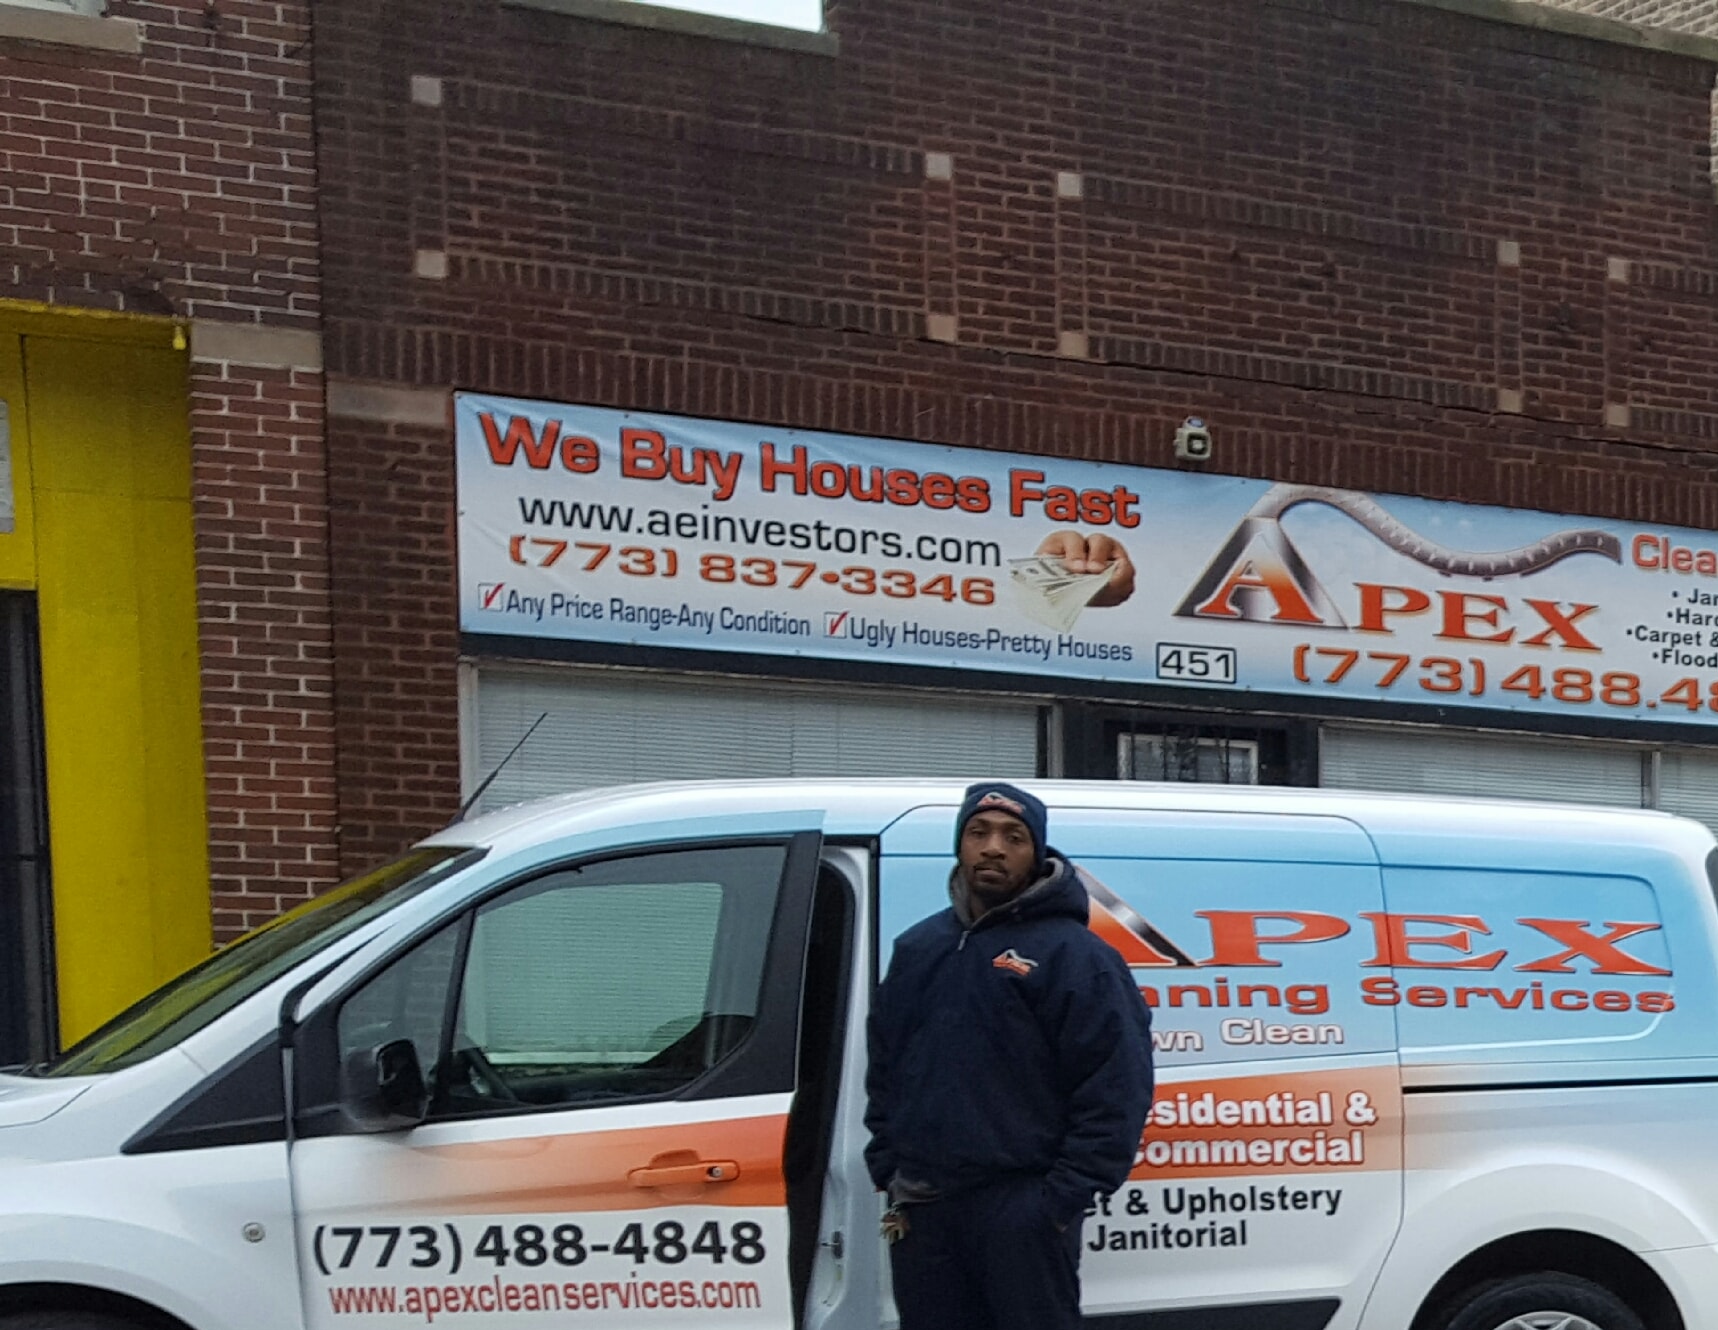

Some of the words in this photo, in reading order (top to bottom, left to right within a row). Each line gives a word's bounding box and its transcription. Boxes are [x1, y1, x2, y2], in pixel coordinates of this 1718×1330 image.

[478, 411, 600, 474] We
[619, 426, 743, 501] Buy
[759, 440, 991, 514] Houses
[1008, 467, 1142, 529] Fast
[517, 496, 1002, 567] www.aeinvestors.com
[508, 534, 679, 579] (773)
[1172, 518, 1603, 653] APEX
[506, 588, 545, 621] Any
[550, 594, 604, 620] Price
[720, 607, 812, 637] Condition
[850, 617, 897, 649] Ugly
[1057, 634, 1134, 662] Houses
[1662, 650, 1718, 669] Flood
[1160, 649, 1234, 678] 451
[1361, 975, 1676, 1013] Services
[1220, 1017, 1344, 1045] Clean
[1150, 1092, 1333, 1126] sidential
[1346, 1092, 1377, 1124] &
[1126, 1188, 1149, 1215] &
[1163, 1185, 1343, 1220] Upholstery
[1087, 1220, 1248, 1252] Janitorial
[328, 1271, 762, 1323] www.apexcleanservices.com
